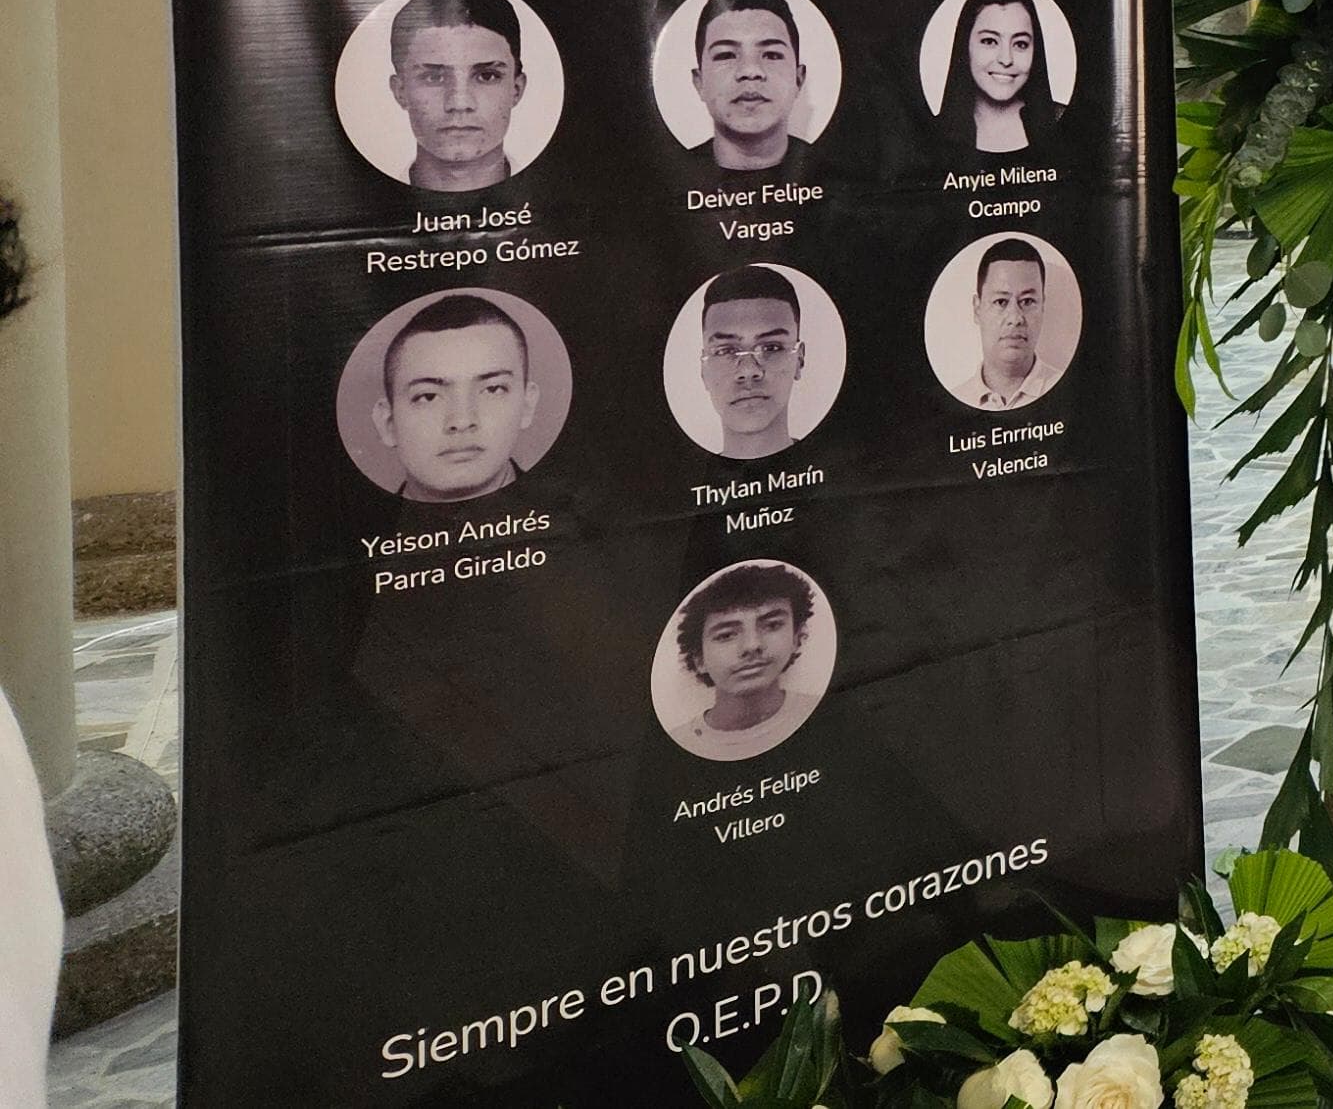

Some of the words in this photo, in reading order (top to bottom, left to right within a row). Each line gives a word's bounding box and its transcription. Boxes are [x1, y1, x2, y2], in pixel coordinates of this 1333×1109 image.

[686, 187, 757, 211] Deiver
[762, 180, 824, 206] Felipe
[943, 171, 996, 193] Anyie
[1000, 166, 1058, 186] Milena
[412, 210, 472, 235] Juan
[478, 202, 532, 231] José
[968, 197, 1042, 220] Ocampo
[719, 216, 795, 242] Vargas
[366, 242, 489, 274] Restrepo
[495, 236, 581, 263] Gómez
[949, 431, 986, 453] Luis
[990, 420, 1065, 447] Enrrique
[971, 451, 1049, 480] Valencia
[691, 475, 762, 507] Thylan
[768, 464, 825, 491] Marín
[360, 529, 450, 558] Yeison
[458, 509, 551, 544] Andrés
[725, 504, 795, 534] Muñoz
[375, 567, 446, 594] Parra
[453, 546, 547, 580] Giraldo
[672, 784, 754, 823] Andrés
[759, 768, 821, 799] Felipe
[713, 812, 786, 844] Villero
[380, 987, 586, 1080] Siempre
[600, 965, 655, 1006] en
[670, 897, 853, 986] nuestros
[864, 836, 1050, 919] corazones
